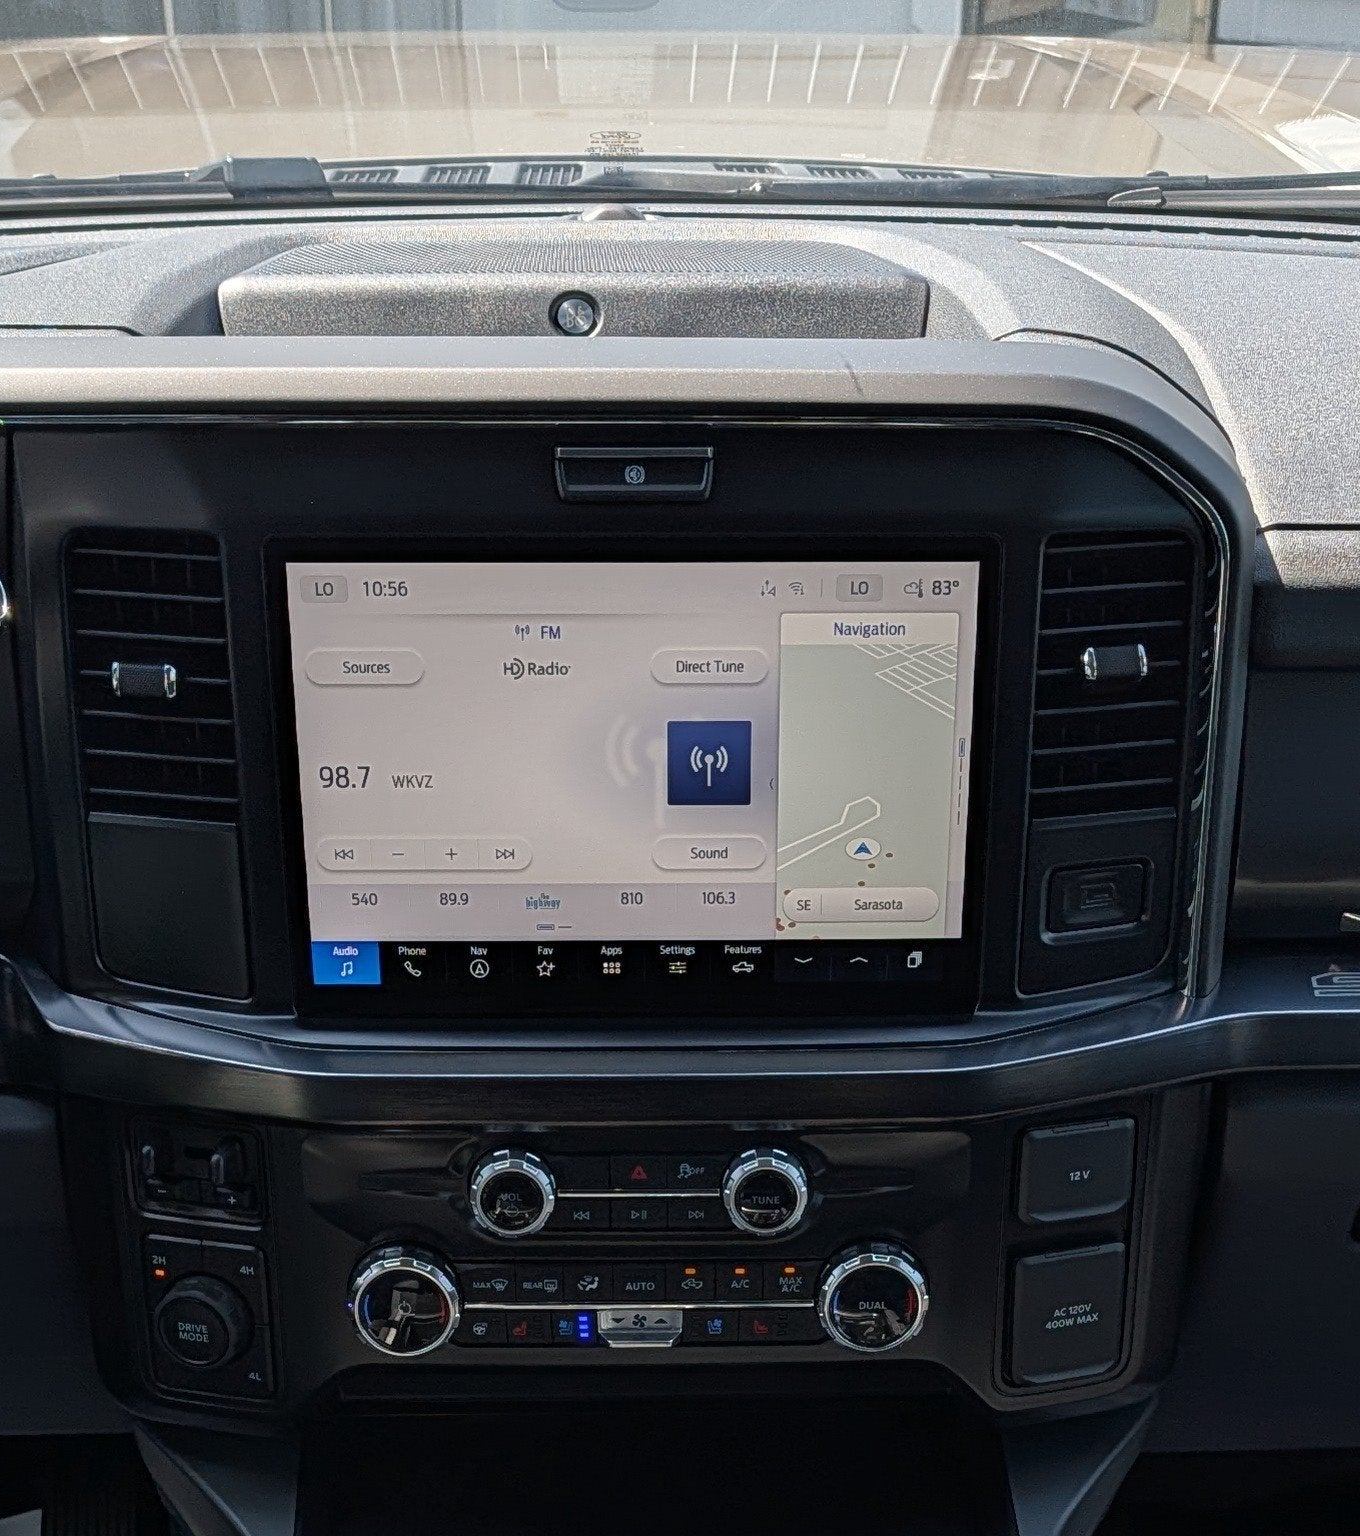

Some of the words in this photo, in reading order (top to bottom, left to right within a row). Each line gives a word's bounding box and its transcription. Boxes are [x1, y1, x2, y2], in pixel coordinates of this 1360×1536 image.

[314, 582, 334, 597] LO
[362, 581, 408, 597] 10:56
[850, 581, 869, 595] LO
[932, 580, 960, 595] 83°
[540, 626, 561, 640] FM
[833, 622, 906, 638] Navigation
[342, 661, 391, 675] Sources
[527, 662, 572, 677] Radio
[675, 661, 712, 673] Direct
[714, 661, 744, 673] Tune
[319, 766, 371, 789] 98.7
[392, 775, 434, 789] WKVZ
[690, 846, 729, 860] Sound
[351, 892, 378, 906] 540
[439, 892, 469, 906] 89.9
[620, 892, 643, 906] 810
[701, 892, 736, 906] 106.3
[854, 898, 903, 911] Sarasota
[796, 899, 812, 912] SE
[332, 946, 359, 957] Audio
[398, 946, 427, 957] Phone
[470, 946, 488, 957] Nav
[537, 946, 554, 957] Fav
[600, 945, 623, 956] Apps
[659, 945, 696, 956] Settings
[724, 944, 762, 954] Features
[1069, 1171, 1081, 1182] 12
[1083, 1169, 1091, 1179] V
[751, 1196, 781, 1204] TUNE
[152, 1255, 166, 1265] 2H
[240, 1266, 254, 1275] 4H
[625, 1282, 655, 1291] AUTO
[731, 1279, 749, 1288] A/C
[779, 1277, 802, 1285] MAX
[859, 1301, 888, 1310] DUAL
[1053, 1307, 1066, 1317] AC
[1045, 1319, 1074, 1330] 400W
[1076, 1312, 1099, 1325] MAX
[178, 1322, 208, 1334] DRIVE
[179, 1331, 209, 1343] MODE
[248, 1372, 262, 1381] 4L
